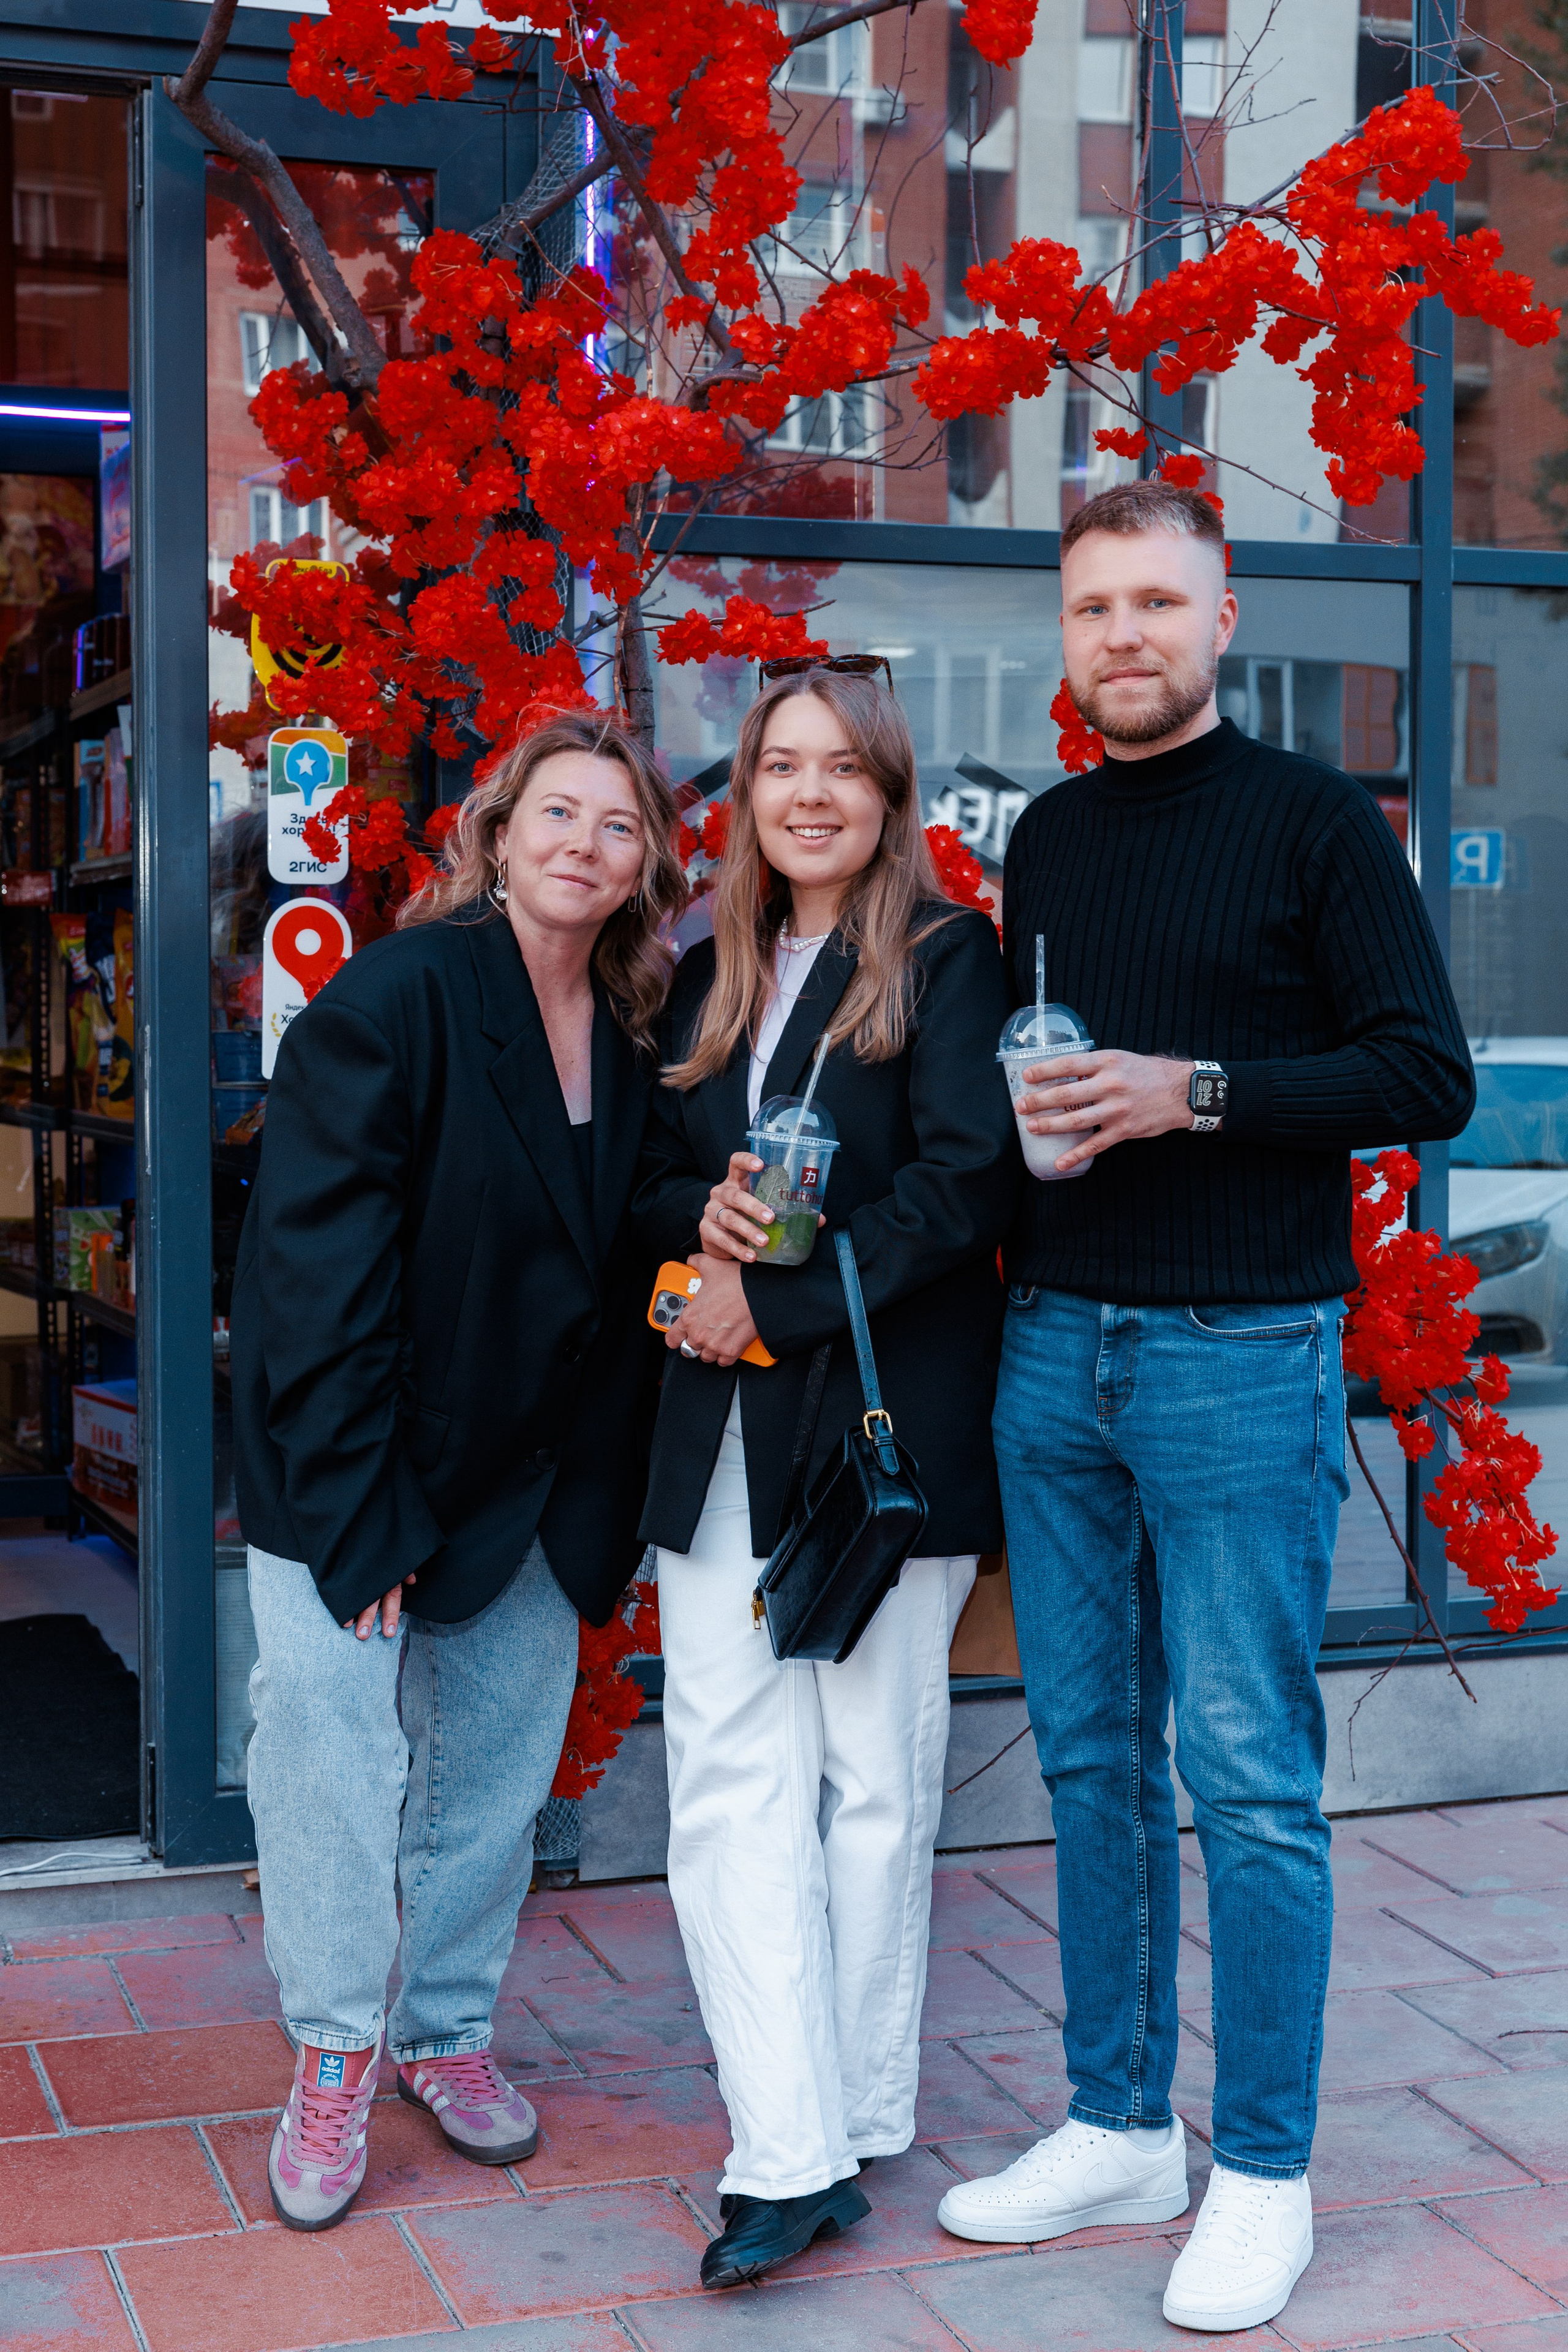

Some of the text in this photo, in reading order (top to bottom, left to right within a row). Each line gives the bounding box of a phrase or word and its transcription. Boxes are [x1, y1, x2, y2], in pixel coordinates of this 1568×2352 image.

[290, 813, 328, 824] Здь
[289, 861, 327, 872] 2ГИС
[1196, 1079, 1213, 1093] 01
[1196, 1093, 1213, 1106] 21
